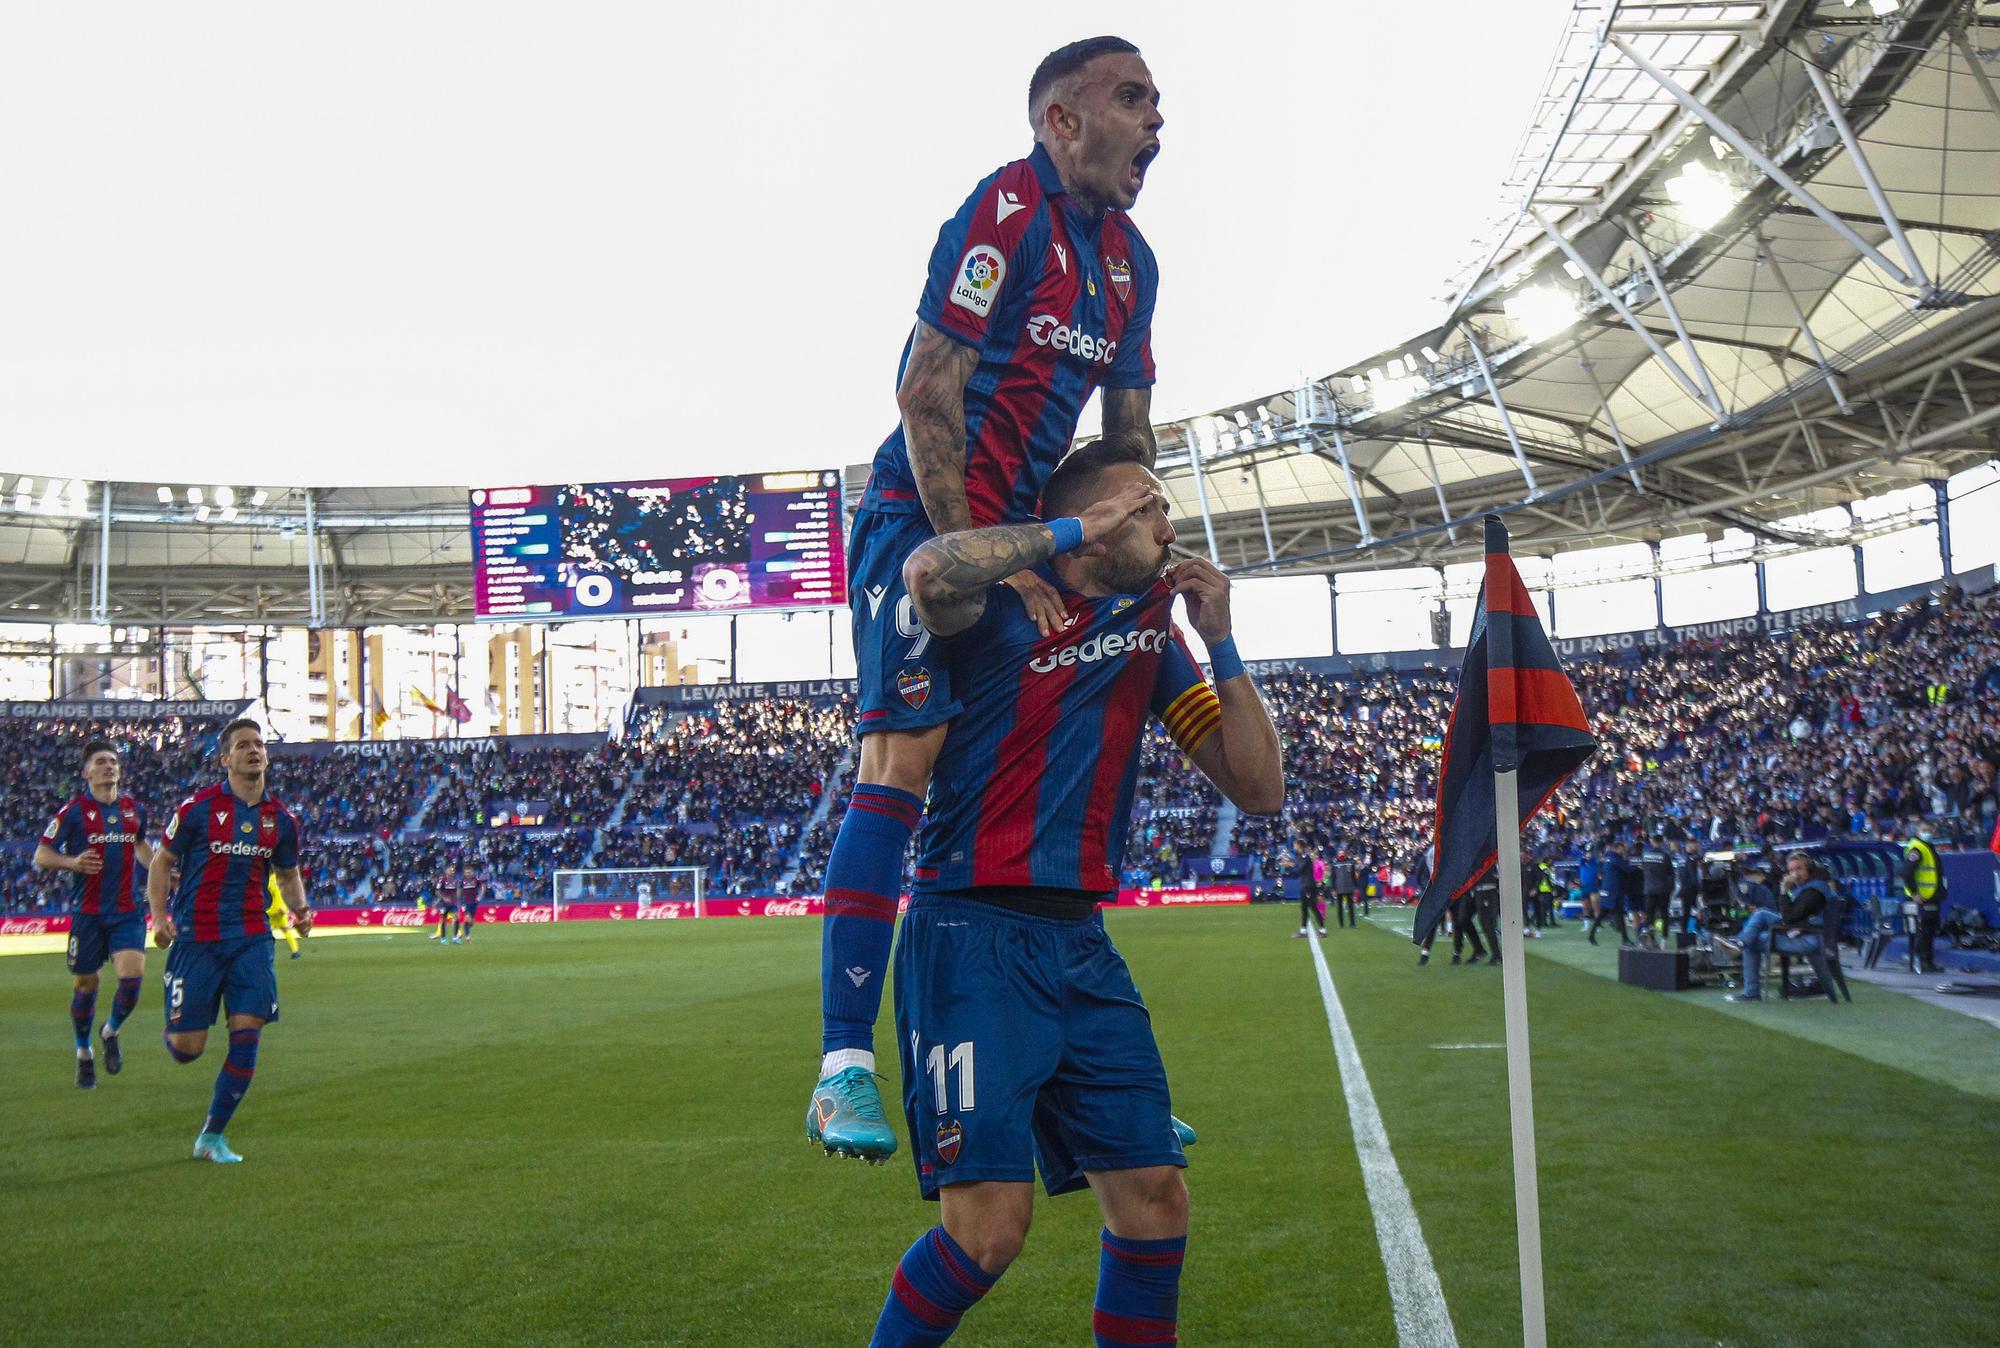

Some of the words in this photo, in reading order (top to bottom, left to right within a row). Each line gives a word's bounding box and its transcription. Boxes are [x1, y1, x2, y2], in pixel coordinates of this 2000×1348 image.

[956, 286, 988, 307] LaLiga
[576, 575, 613, 607] 0
[896, 594, 931, 660] 9
[1644, 630, 1668, 646] EL
[1763, 613, 1785, 630] TE
[1791, 601, 1859, 626] ESPERA
[681, 684, 769, 700] LEVANTE,
[777, 684, 800, 697] EN
[809, 681, 843, 696] LAS
[12, 704, 88, 718] GRANDE
[92, 703, 114, 718] ES
[117, 703, 150, 718] SER
[155, 701, 237, 717] PEQUEÑO
[89, 832, 136, 844] Gedesco
[209, 840, 273, 859] Gedesco
[170, 977, 185, 1008] 5
[926, 1041, 976, 1116] 11
